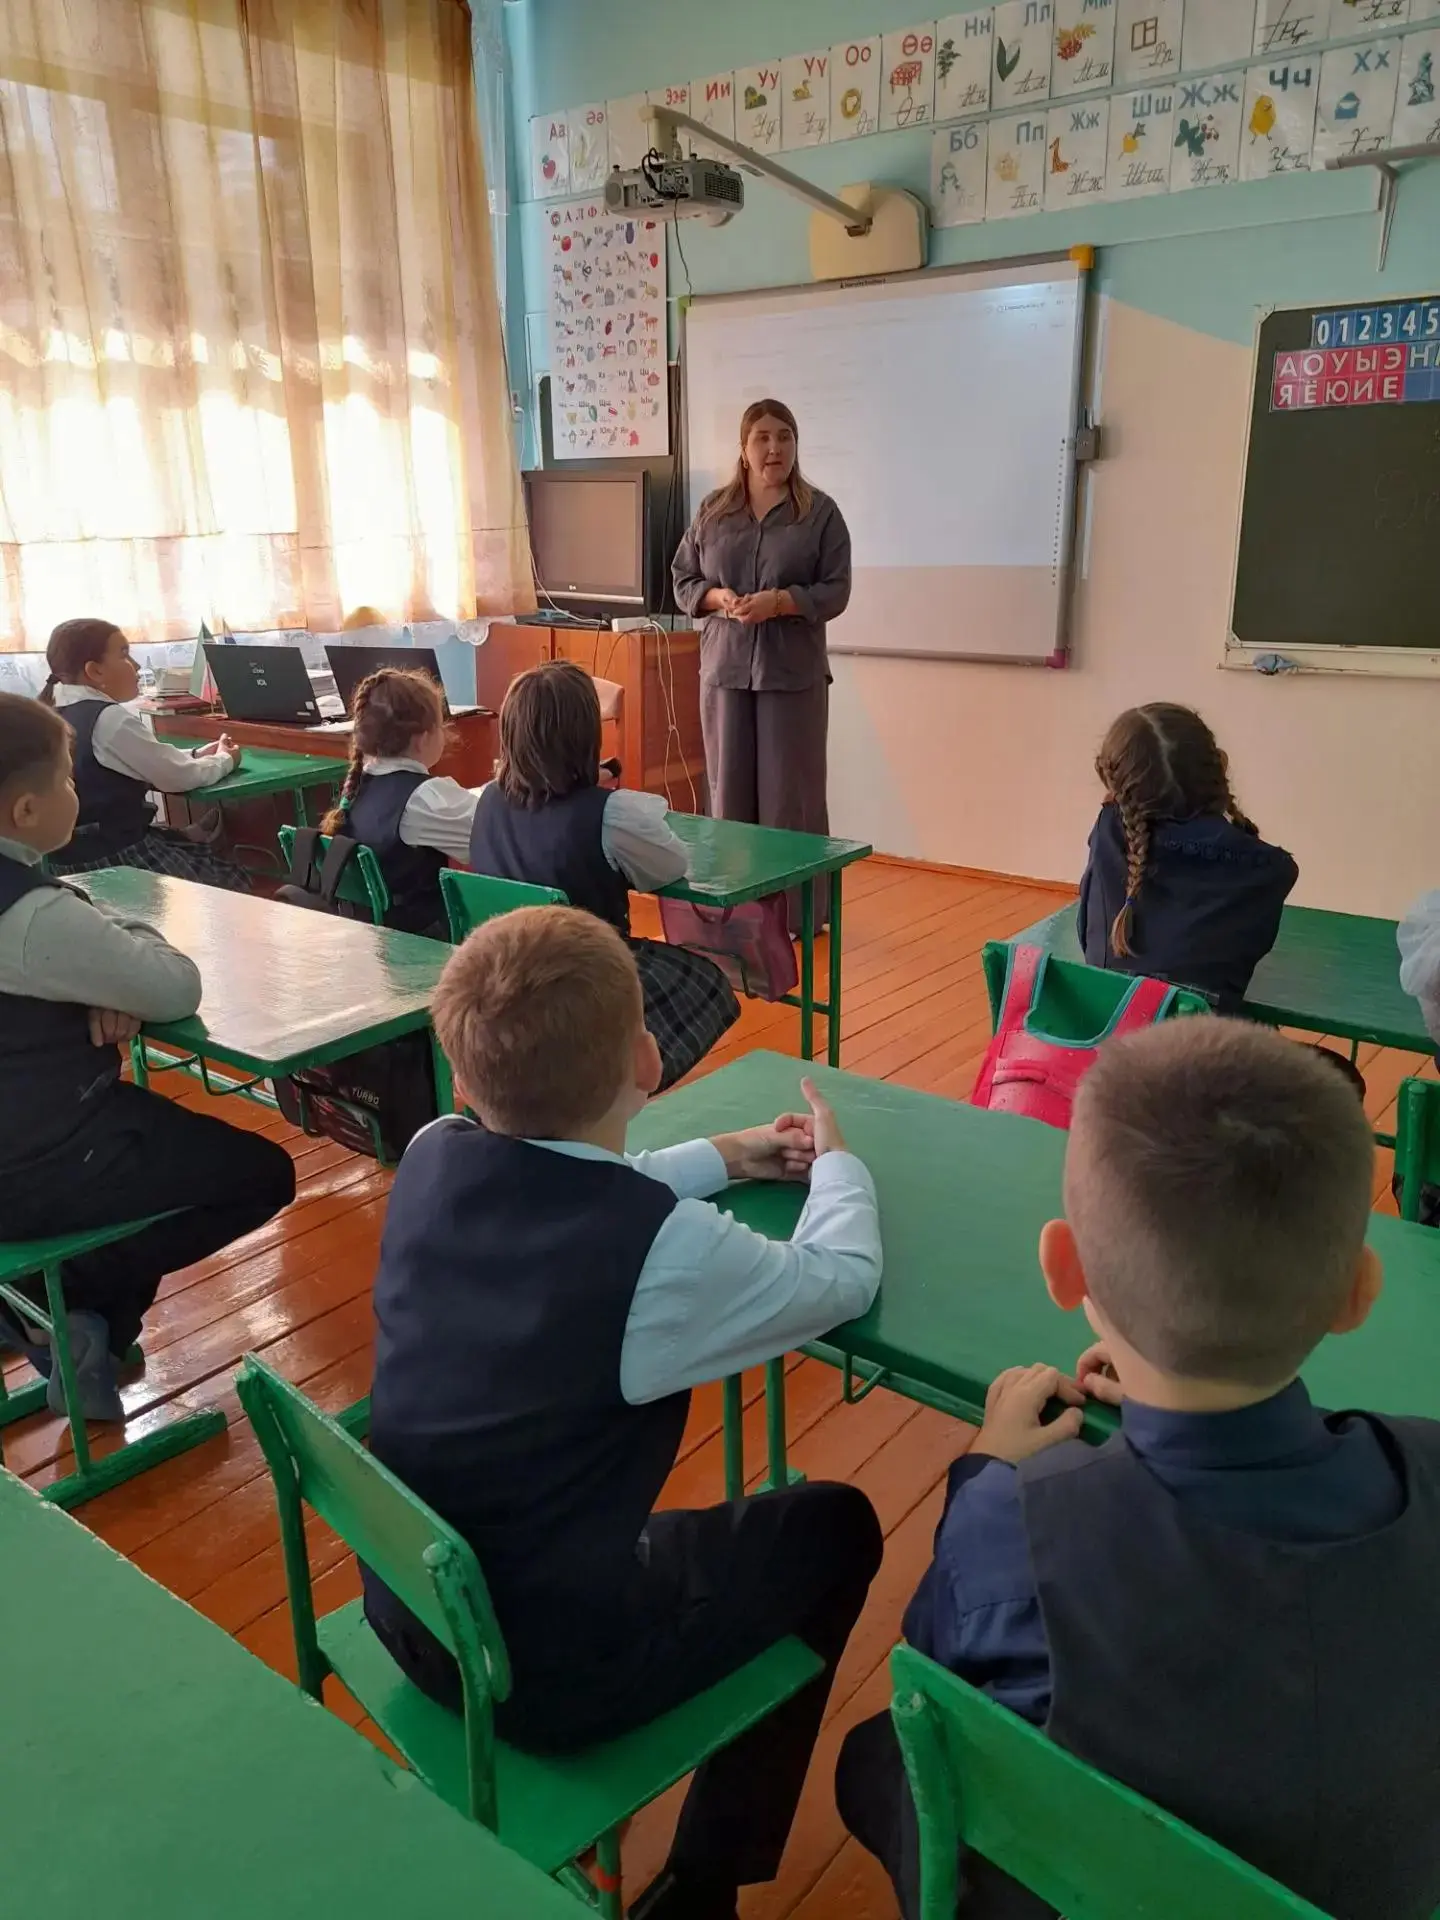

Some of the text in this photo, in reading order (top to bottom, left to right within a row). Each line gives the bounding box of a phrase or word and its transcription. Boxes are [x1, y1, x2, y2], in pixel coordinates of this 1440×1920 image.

[965, 16, 991, 38] Нн
[846, 45, 872, 66] Оо
[1352, 50, 1390, 75] Хх
[1269, 67, 1312, 92] Чч
[706, 82, 730, 102] Ии
[1132, 93, 1172, 118] Шш
[1017, 121, 1044, 144] Пп
[1069, 111, 1101, 132] Жж
[950, 125, 979, 152] Бб
[352, 1087, 380, 1105] TURBO
